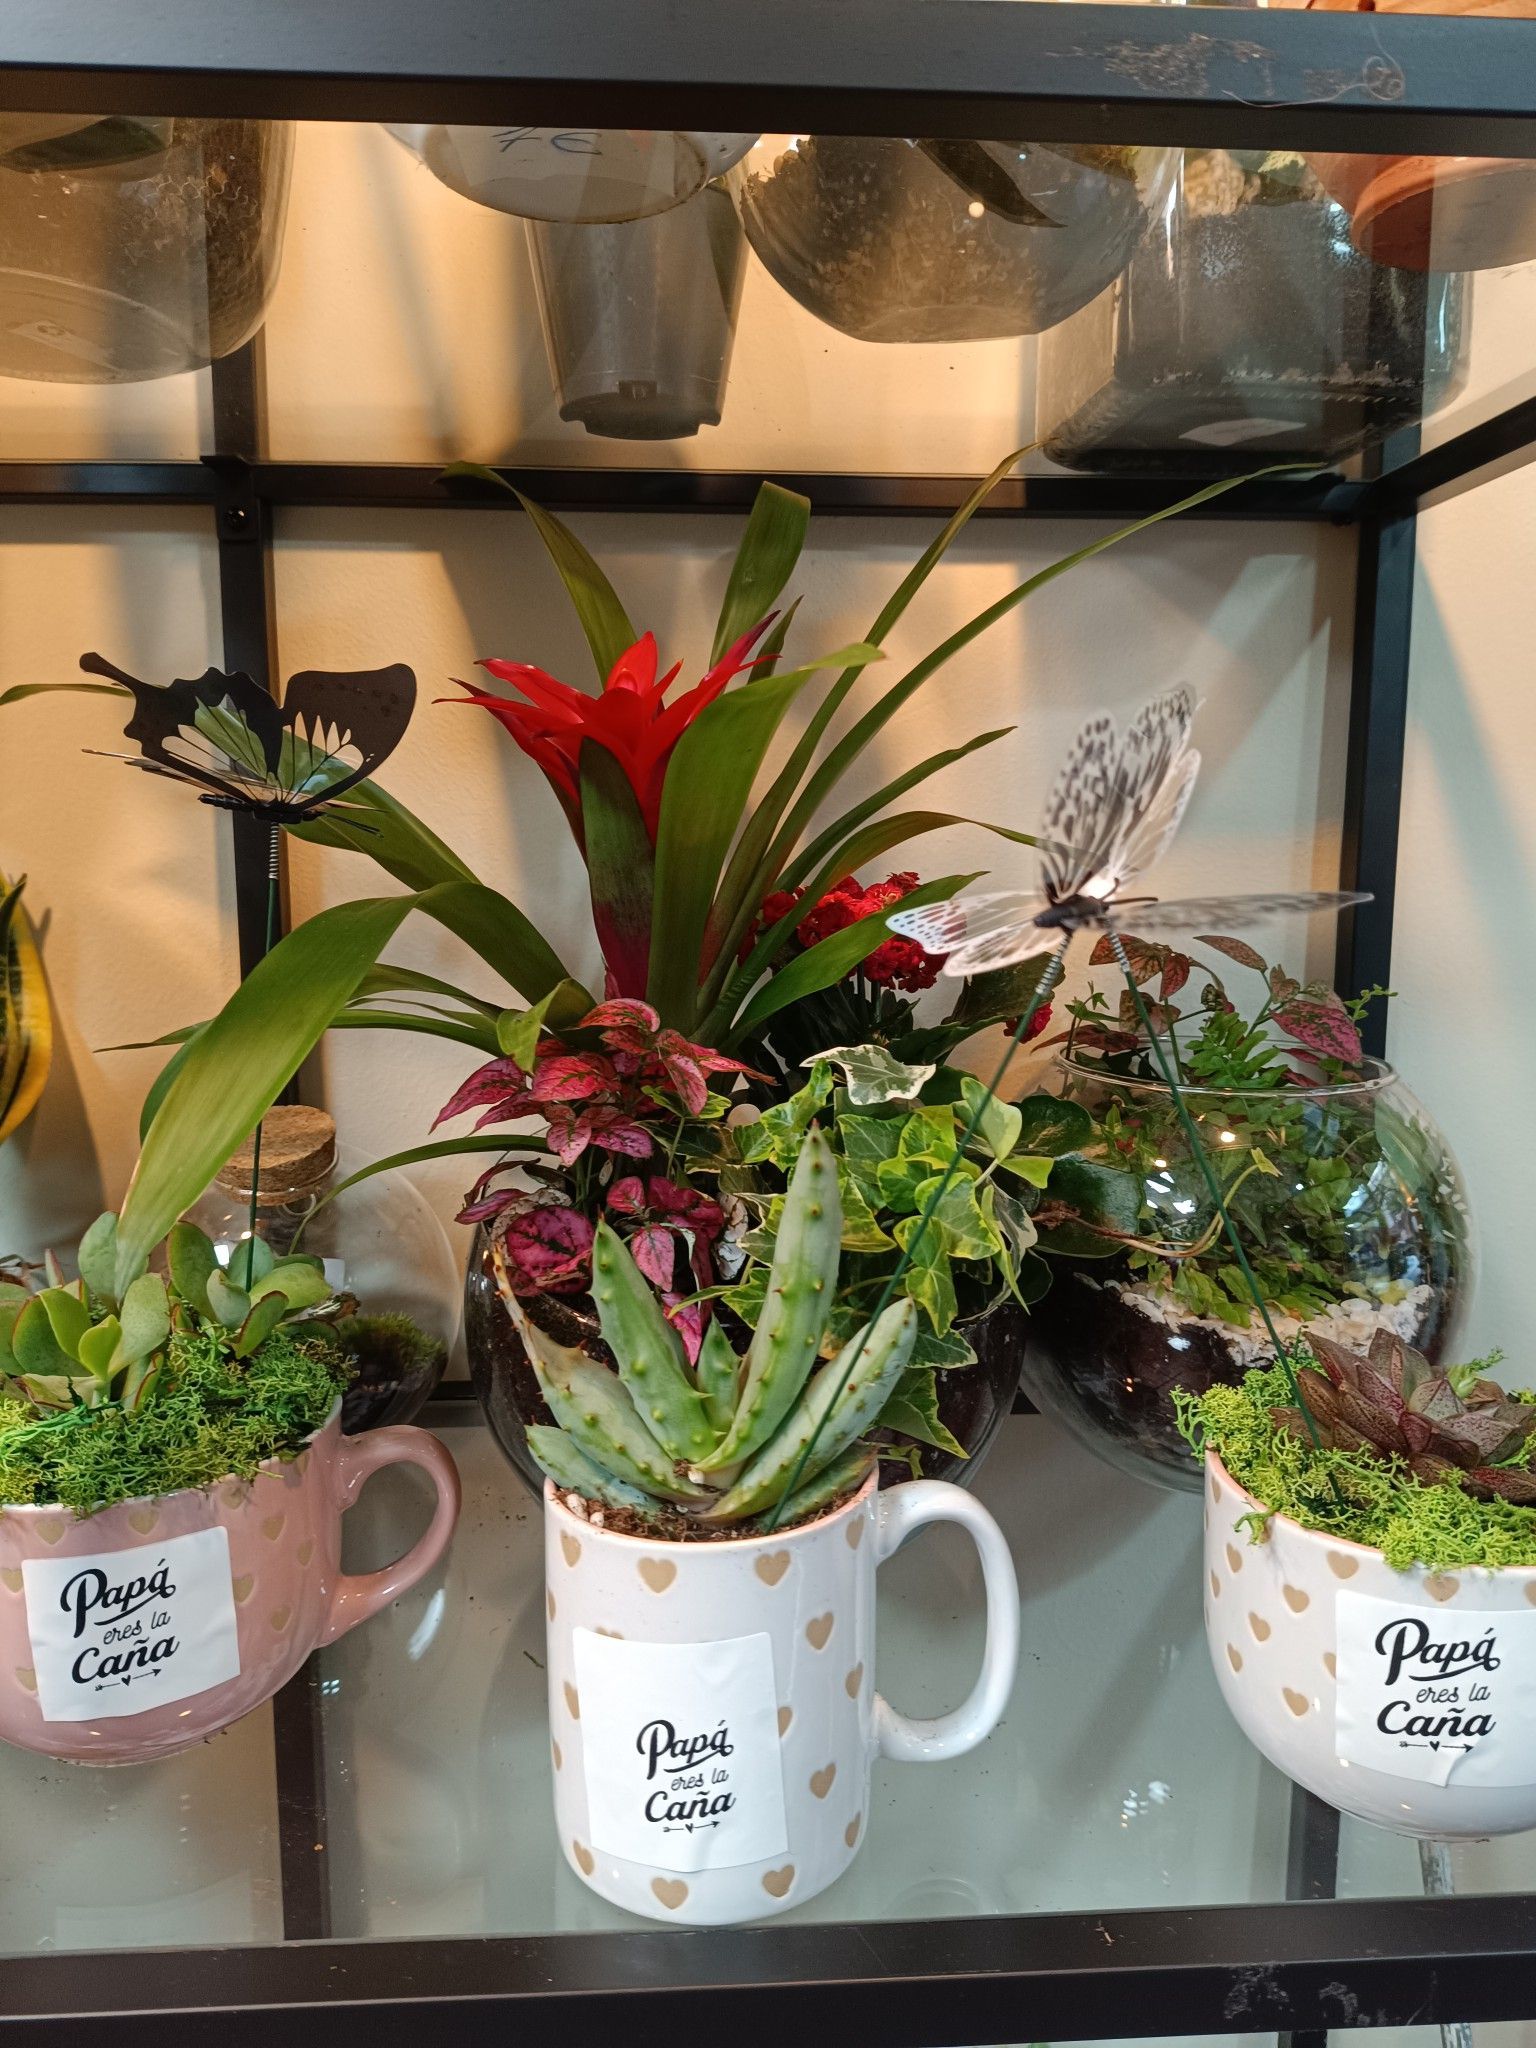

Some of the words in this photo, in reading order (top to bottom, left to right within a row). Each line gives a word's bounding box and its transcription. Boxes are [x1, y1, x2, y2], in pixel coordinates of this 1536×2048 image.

[59, 1558, 176, 1638] Papá
[103, 1620, 142, 1645] eres
[151, 1610, 171, 1630] la
[71, 1636, 180, 1684] Caña
[1375, 1617, 1501, 1686] Papá
[1416, 1686, 1459, 1703] eres
[1469, 1683, 1491, 1701] la
[1377, 1700, 1497, 1737] Caña
[636, 1719, 734, 1780] Papá
[671, 1773, 704, 1791] eres
[711, 1768, 729, 1784] la
[645, 1790, 736, 1822] Caña
